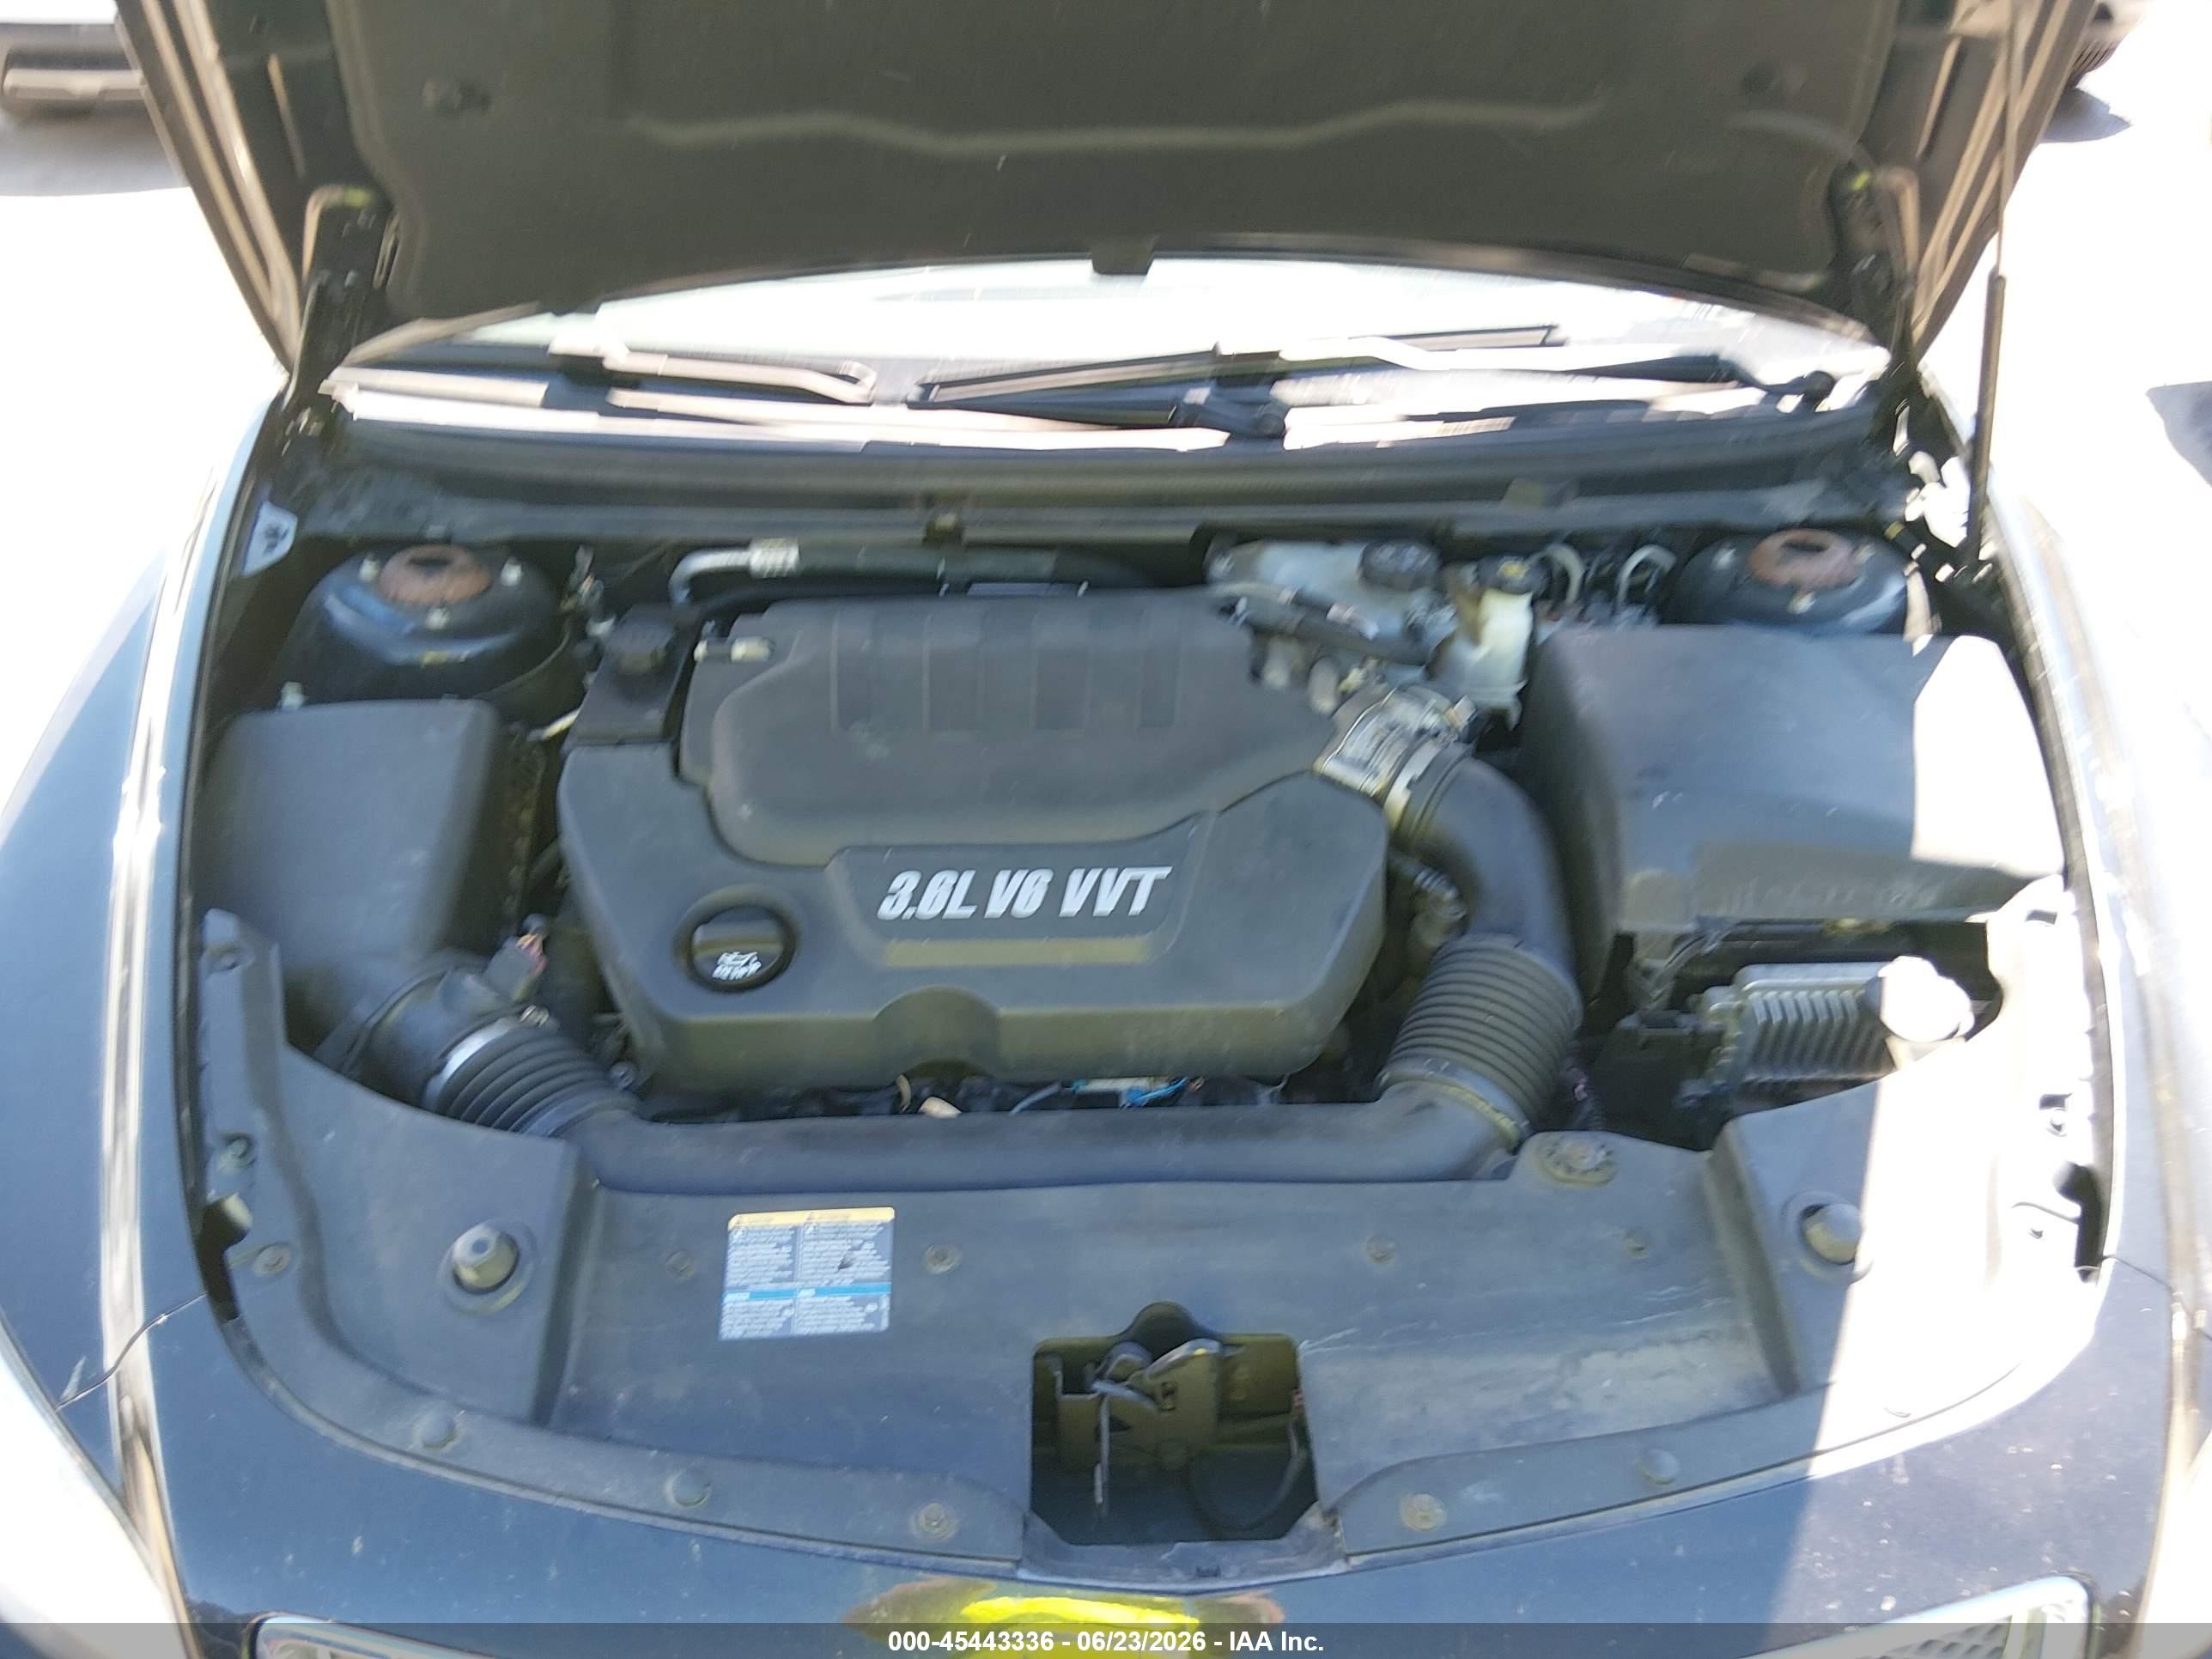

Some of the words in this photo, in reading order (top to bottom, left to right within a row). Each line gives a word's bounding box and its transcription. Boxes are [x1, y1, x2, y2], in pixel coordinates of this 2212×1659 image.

[877, 870, 977, 921] 3.6L
[984, 869, 1054, 919] V6
[1059, 866, 1173, 917] VVT
